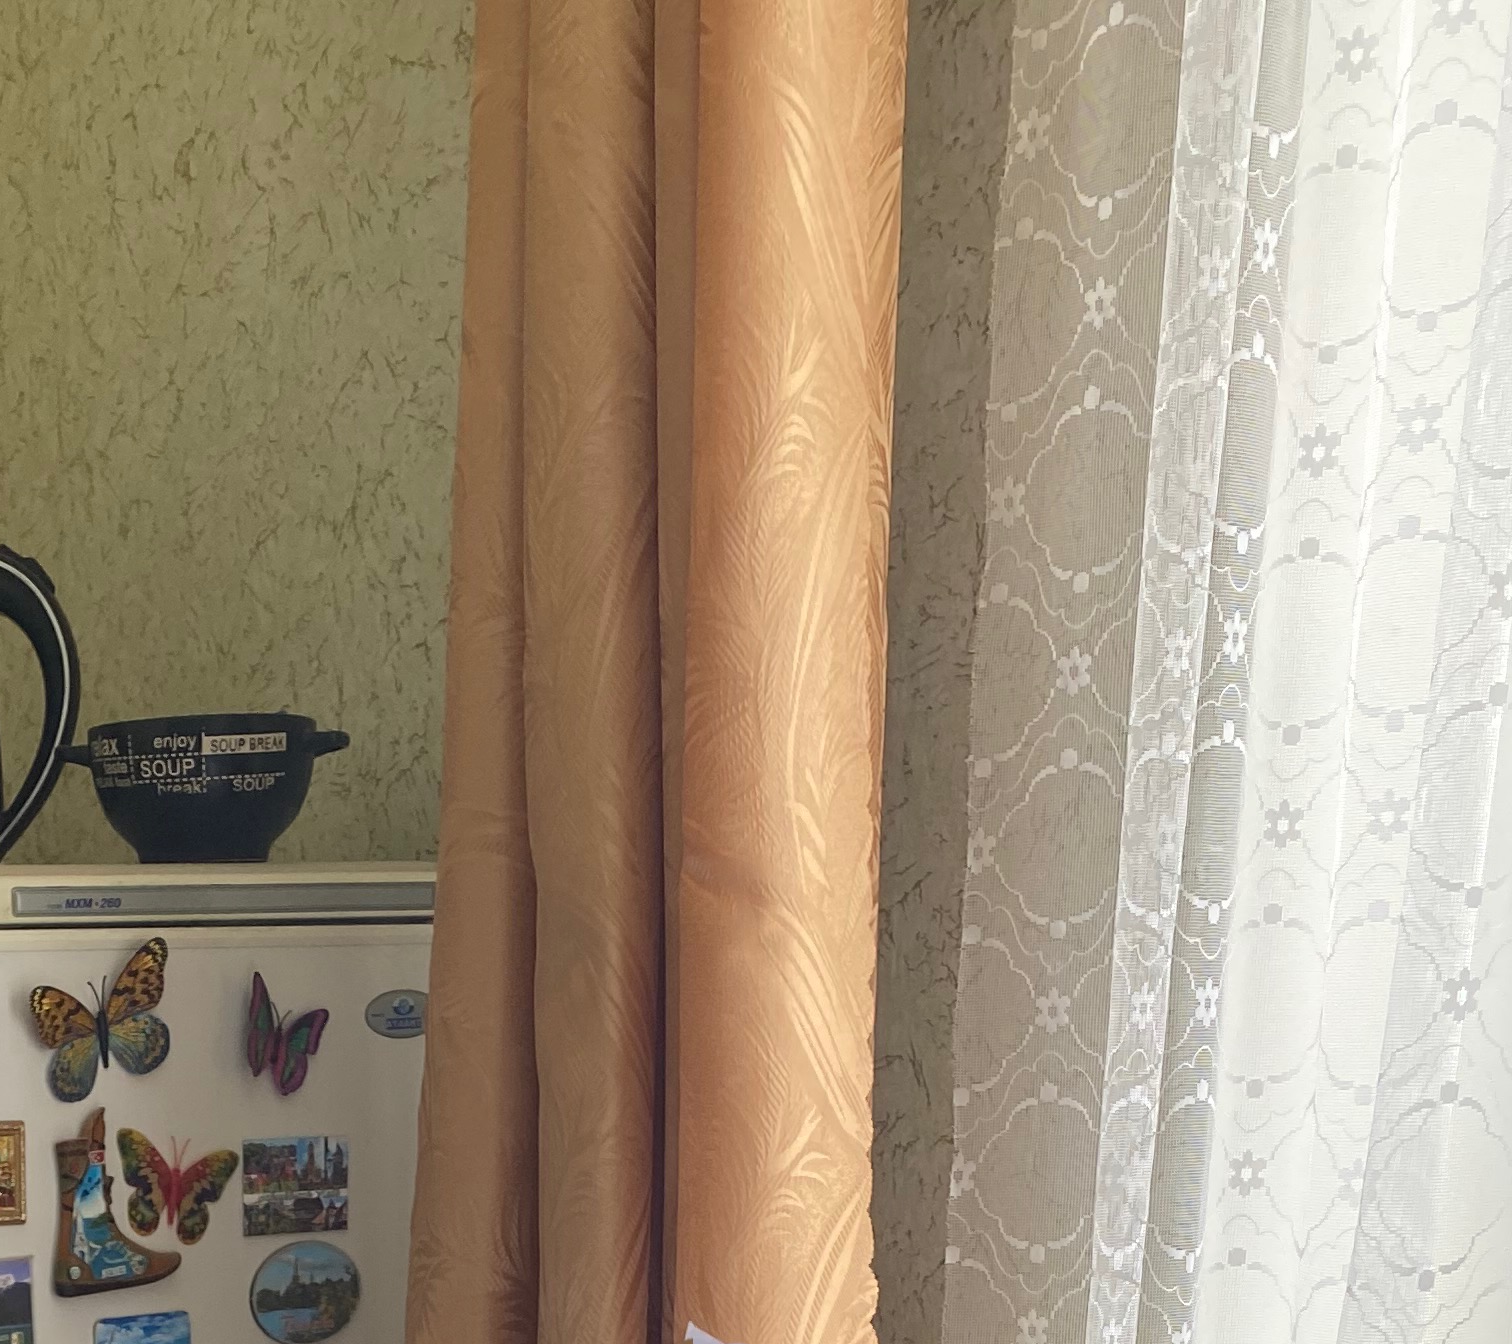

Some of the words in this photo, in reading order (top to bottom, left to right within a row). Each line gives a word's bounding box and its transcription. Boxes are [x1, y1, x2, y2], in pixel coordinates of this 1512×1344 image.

[154, 733, 197, 751] enjoy
[210, 738, 246, 753] SOUP
[249, 736, 285, 751] BREAK
[139, 758, 196, 778] SOUP
[232, 777, 276, 793] SOUP
